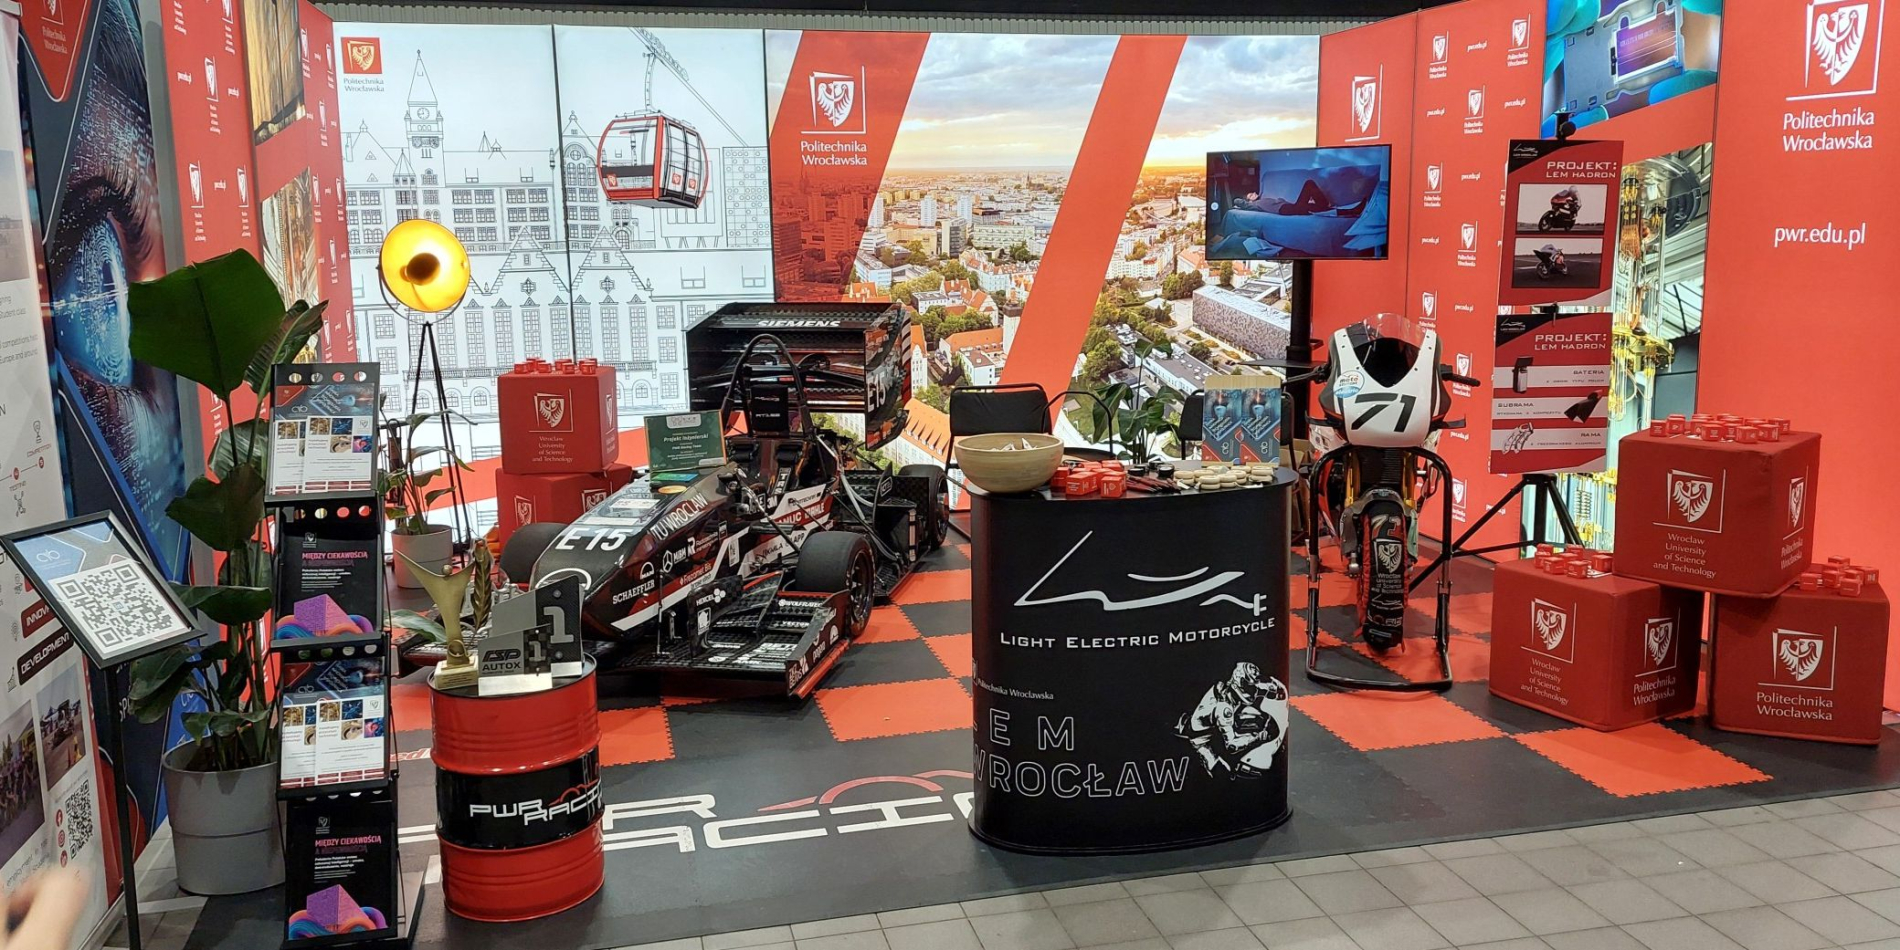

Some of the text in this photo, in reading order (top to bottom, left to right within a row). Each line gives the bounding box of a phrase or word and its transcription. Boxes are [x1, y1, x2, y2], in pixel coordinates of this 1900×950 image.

[1783, 107, 1875, 130] Politechnika
[801, 140, 867, 152] Politechnika
[1783, 130, 1873, 152] Wrocławska
[802, 154, 868, 166] Wrocławska
[1547, 161, 1617, 170] PROJEKT:
[1774, 222, 1866, 250] pwr.edu.pl
[757, 320, 841, 328] SIEMENS
[1535, 333, 1607, 343] PROJEKT:
[866, 371, 886, 413] E15
[1351, 393, 1418, 433] 71
[650, 493, 709, 541] TU WROCLAW
[778, 511, 802, 525] ANUC
[1667, 533, 1705, 545] Wroclaw
[302, 551, 368, 560] MIĘDZY CIEKAWOŚCIĄ
[1664, 552, 1706, 565] of Science
[1665, 543, 1707, 557] University
[1653, 562, 1717, 579] and Technology
[612, 579, 655, 605] SCHAEFFLER
[543, 606, 575, 644] 1
[1000, 617, 1275, 648] LIGHT ELECTRIC MOTORCYCLE
[21, 632, 70, 674] DEVELOPMENT
[528, 641, 546, 662] 1
[482, 661, 521, 672] AUTOX
[1531, 658, 1561, 673] Wroclaw
[1530, 667, 1562, 683] University
[1529, 676, 1561, 693] of Science
[1633, 676, 1676, 694] Politechnika
[1520, 683, 1569, 706] and Technology
[1633, 688, 1676, 706] Wrocławska
[1756, 691, 1834, 708] Politechnika
[1757, 704, 1833, 721] Wrocławska
[973, 744, 1189, 798] WROCŁAW
[470, 798, 544, 818] PWR
[315, 835, 382, 847] MIĘDZY CIEKAWOŚCIĄ
